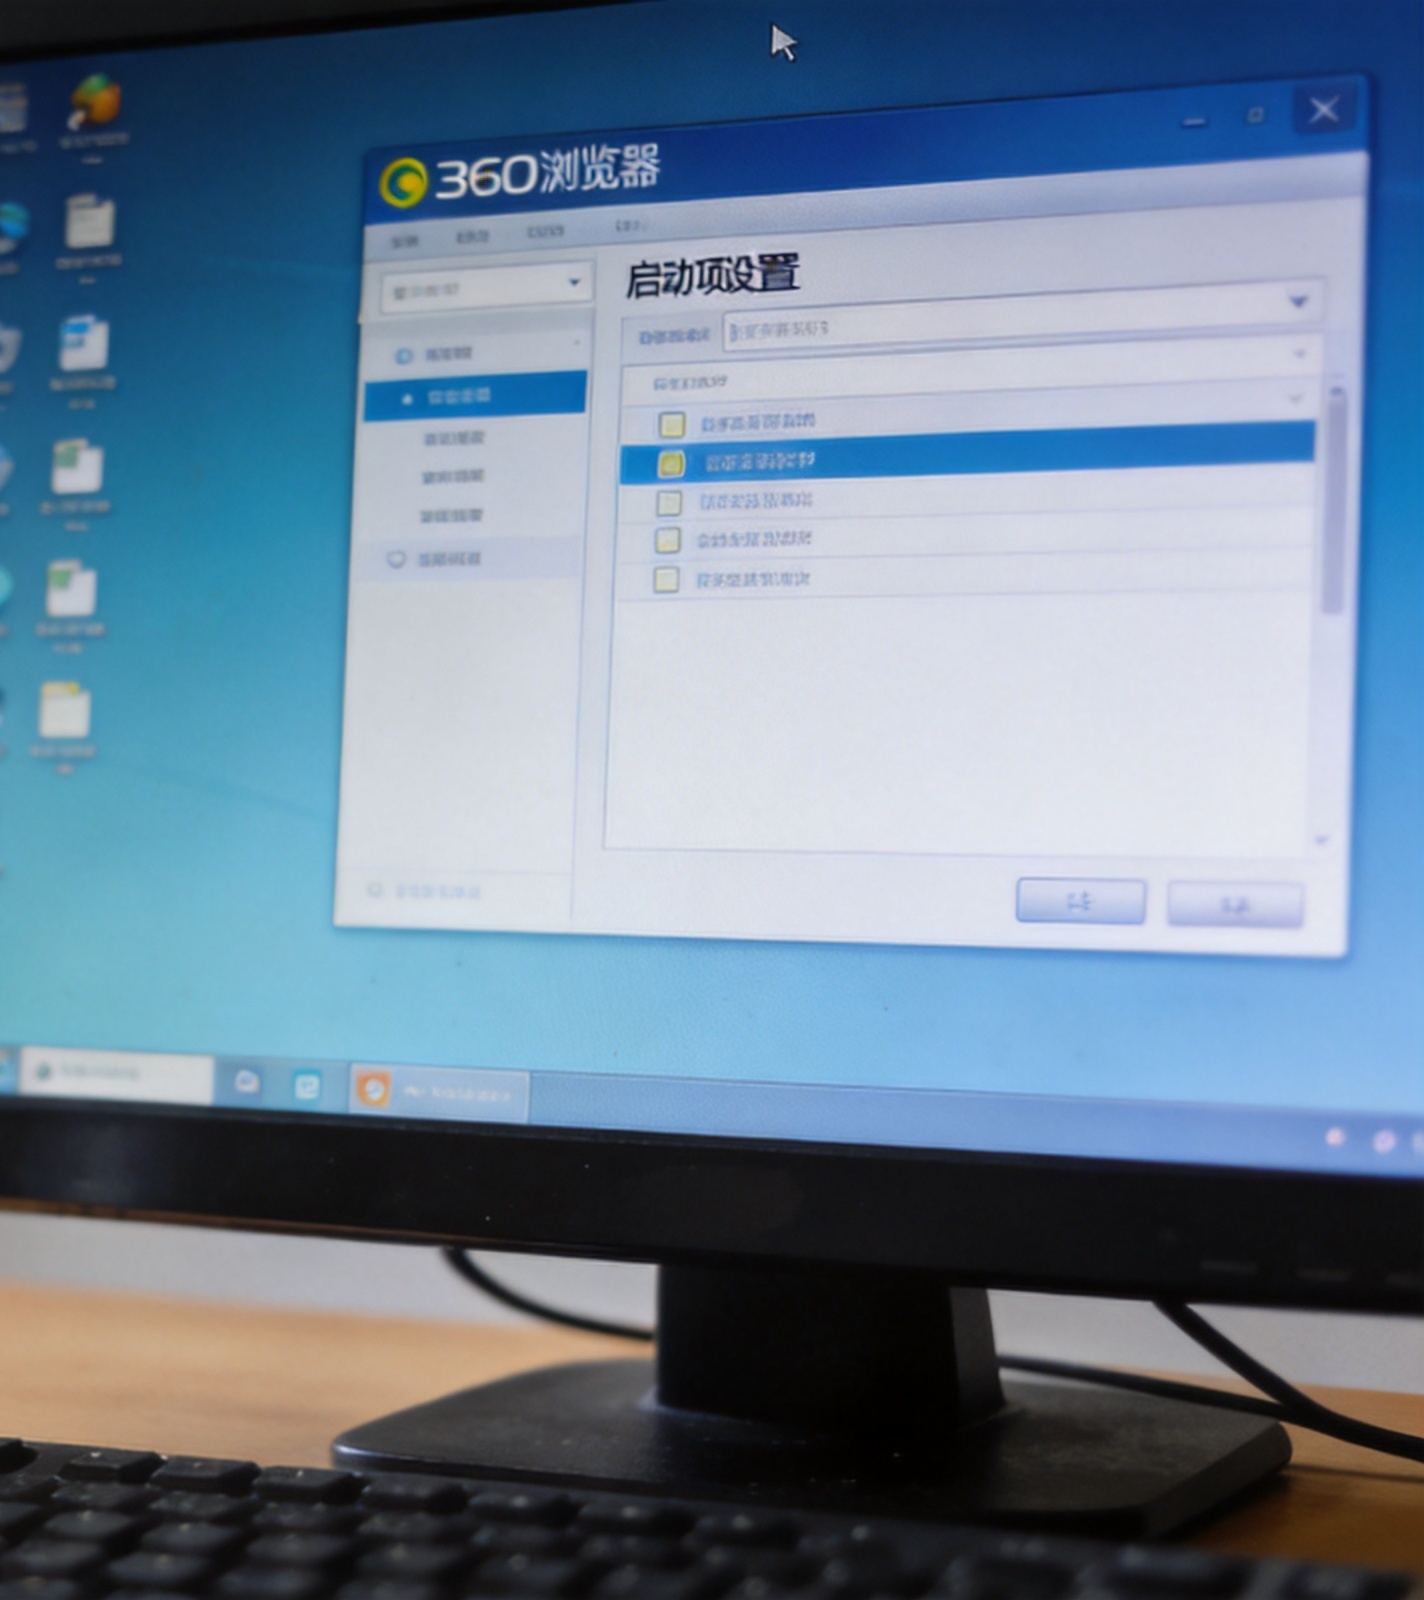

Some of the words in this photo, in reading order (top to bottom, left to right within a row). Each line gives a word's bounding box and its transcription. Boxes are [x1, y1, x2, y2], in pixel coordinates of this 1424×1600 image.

[435, 143, 661, 199] 360浏览器
[627, 252, 801, 299] 启动项设置
